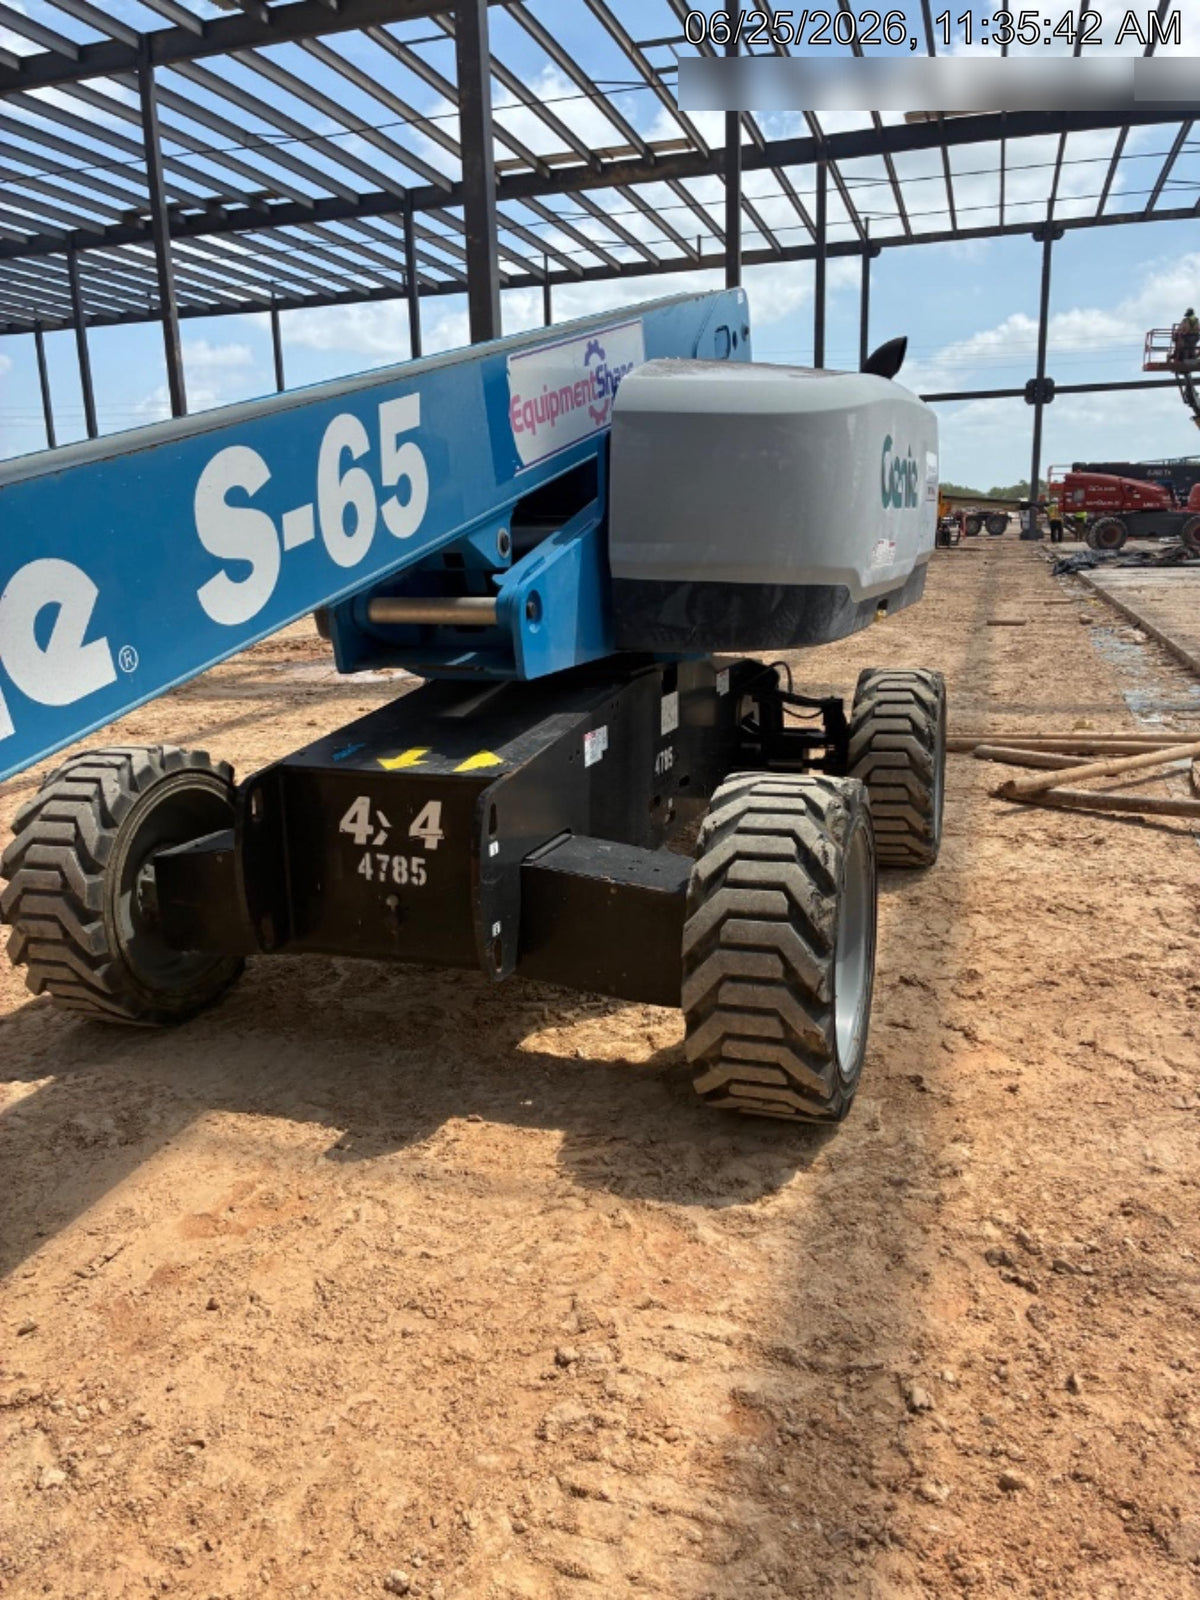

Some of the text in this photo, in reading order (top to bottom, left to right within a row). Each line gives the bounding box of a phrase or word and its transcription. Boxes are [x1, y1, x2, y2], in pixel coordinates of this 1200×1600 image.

[881, 434, 918, 509] Genie
[194, 393, 429, 626] S-65
[357, 852, 428, 886] 4785
